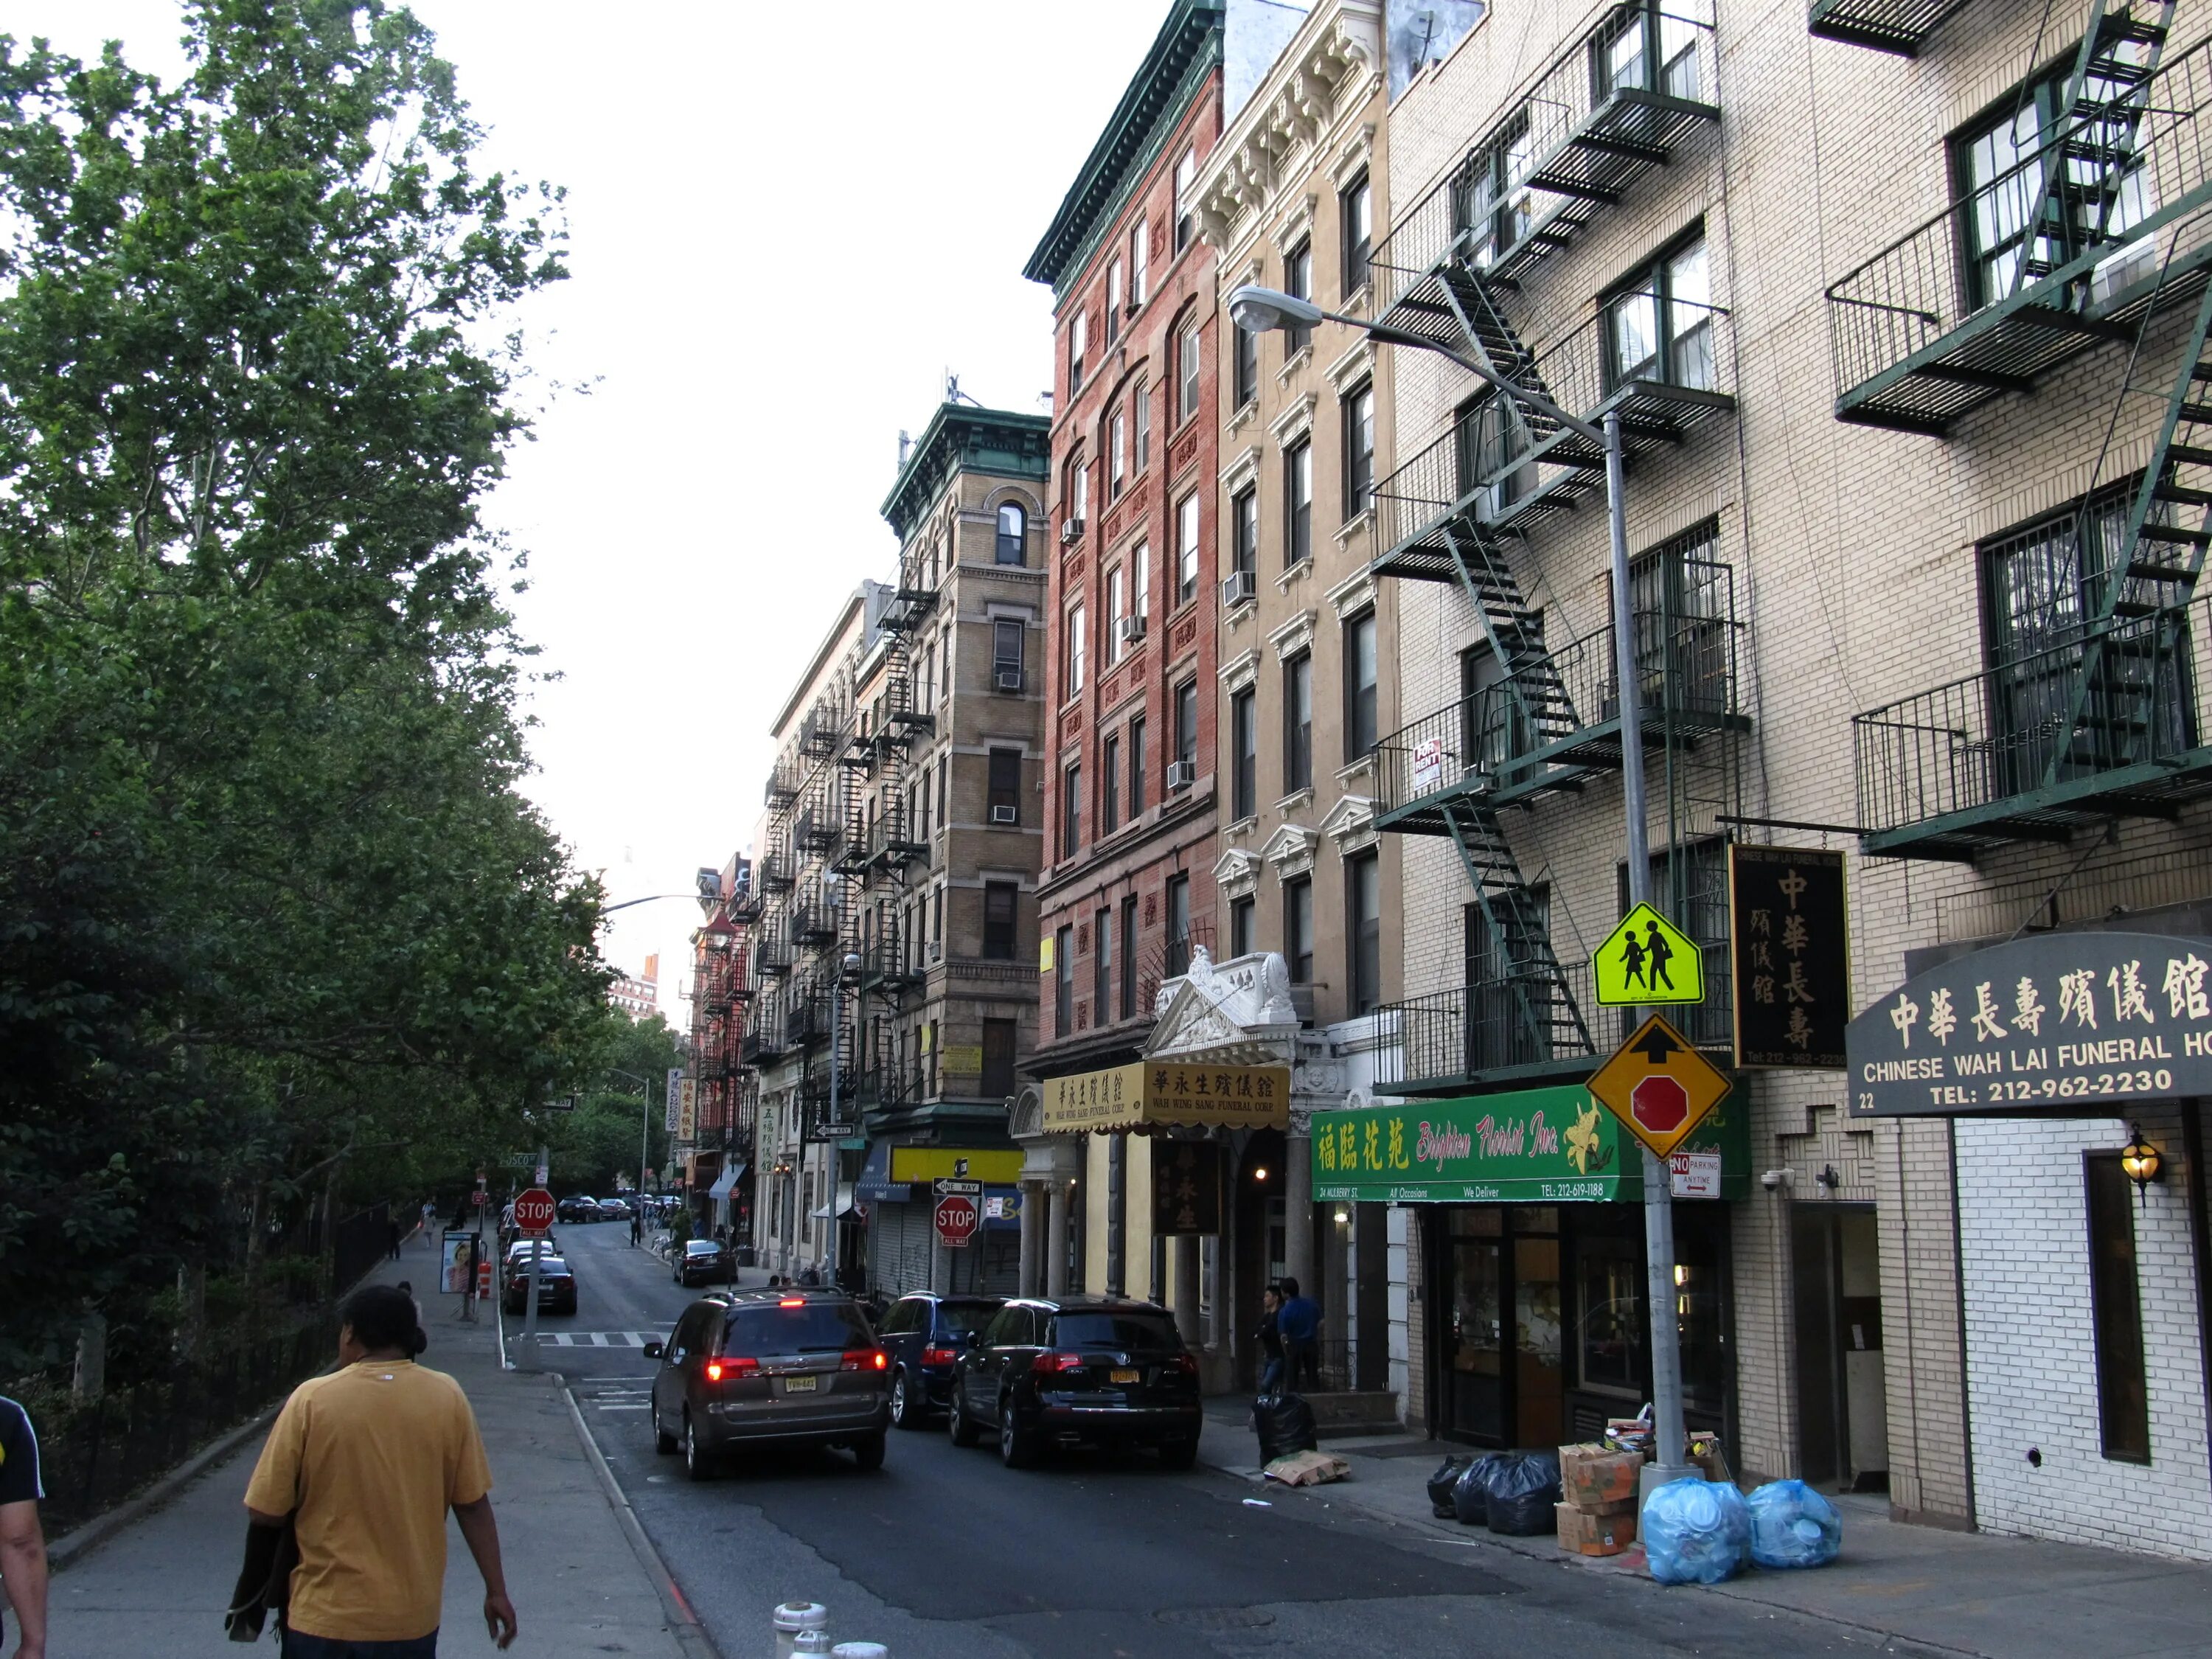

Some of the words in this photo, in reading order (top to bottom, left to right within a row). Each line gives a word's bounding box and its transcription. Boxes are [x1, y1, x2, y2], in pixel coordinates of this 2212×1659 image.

[1417, 742, 1434, 760] FOR
[1416, 752, 1438, 772] RENT
[1736, 850, 1763, 861] CHINESE
[1793, 854, 1820, 866] FUNERAL
[1778, 869, 1815, 1049] 中華長壽
[1890, 952, 2211, 1050] 中華長壽殯儀館
[1863, 1057, 1944, 1083] CHINESE
[1954, 1051, 2001, 1077] WAH
[2011, 1047, 2048, 1072] LAI
[2058, 1035, 2172, 1068] FUNERAL
[1930, 1085, 1978, 1105] TEL:
[1989, 1069, 2172, 1102] 212-962-2230
[1152, 1097, 1169, 1108] WAH
[1173, 1097, 1192, 1109] WING
[1195, 1099, 1214, 1110] SANG
[1218, 1100, 1252, 1111] FUNERAL
[1859, 1092, 1874, 1109] 22
[668, 1089, 678, 1130] LAUNDROMAT
[1090, 1105, 1110, 1116] FUNERAL
[1318, 1117, 1410, 1172] 福臨花苑
[1416, 1120, 1471, 1172] Brighton
[1476, 1114, 1524, 1160] Florist
[1528, 1110, 1559, 1158] Inc.
[1672, 1156, 1689, 1172] NO
[1690, 1161, 1718, 1170] PARKING
[1683, 1176, 1711, 1184] ANYTIME
[1319, 1187, 1326, 1198] 24
[1327, 1187, 1351, 1198] MULBERRY
[1389, 1187, 1397, 1198] All
[1399, 1187, 1427, 1198] Occasions
[1463, 1186, 1475, 1197] We
[1475, 1186, 1499, 1197] Deliver
[1541, 1184, 1556, 1197] TEL:
[1558, 1183, 1604, 1197] 212-619-1188
[518, 1203, 553, 1219] STOP
[938, 1210, 974, 1227] STOP
